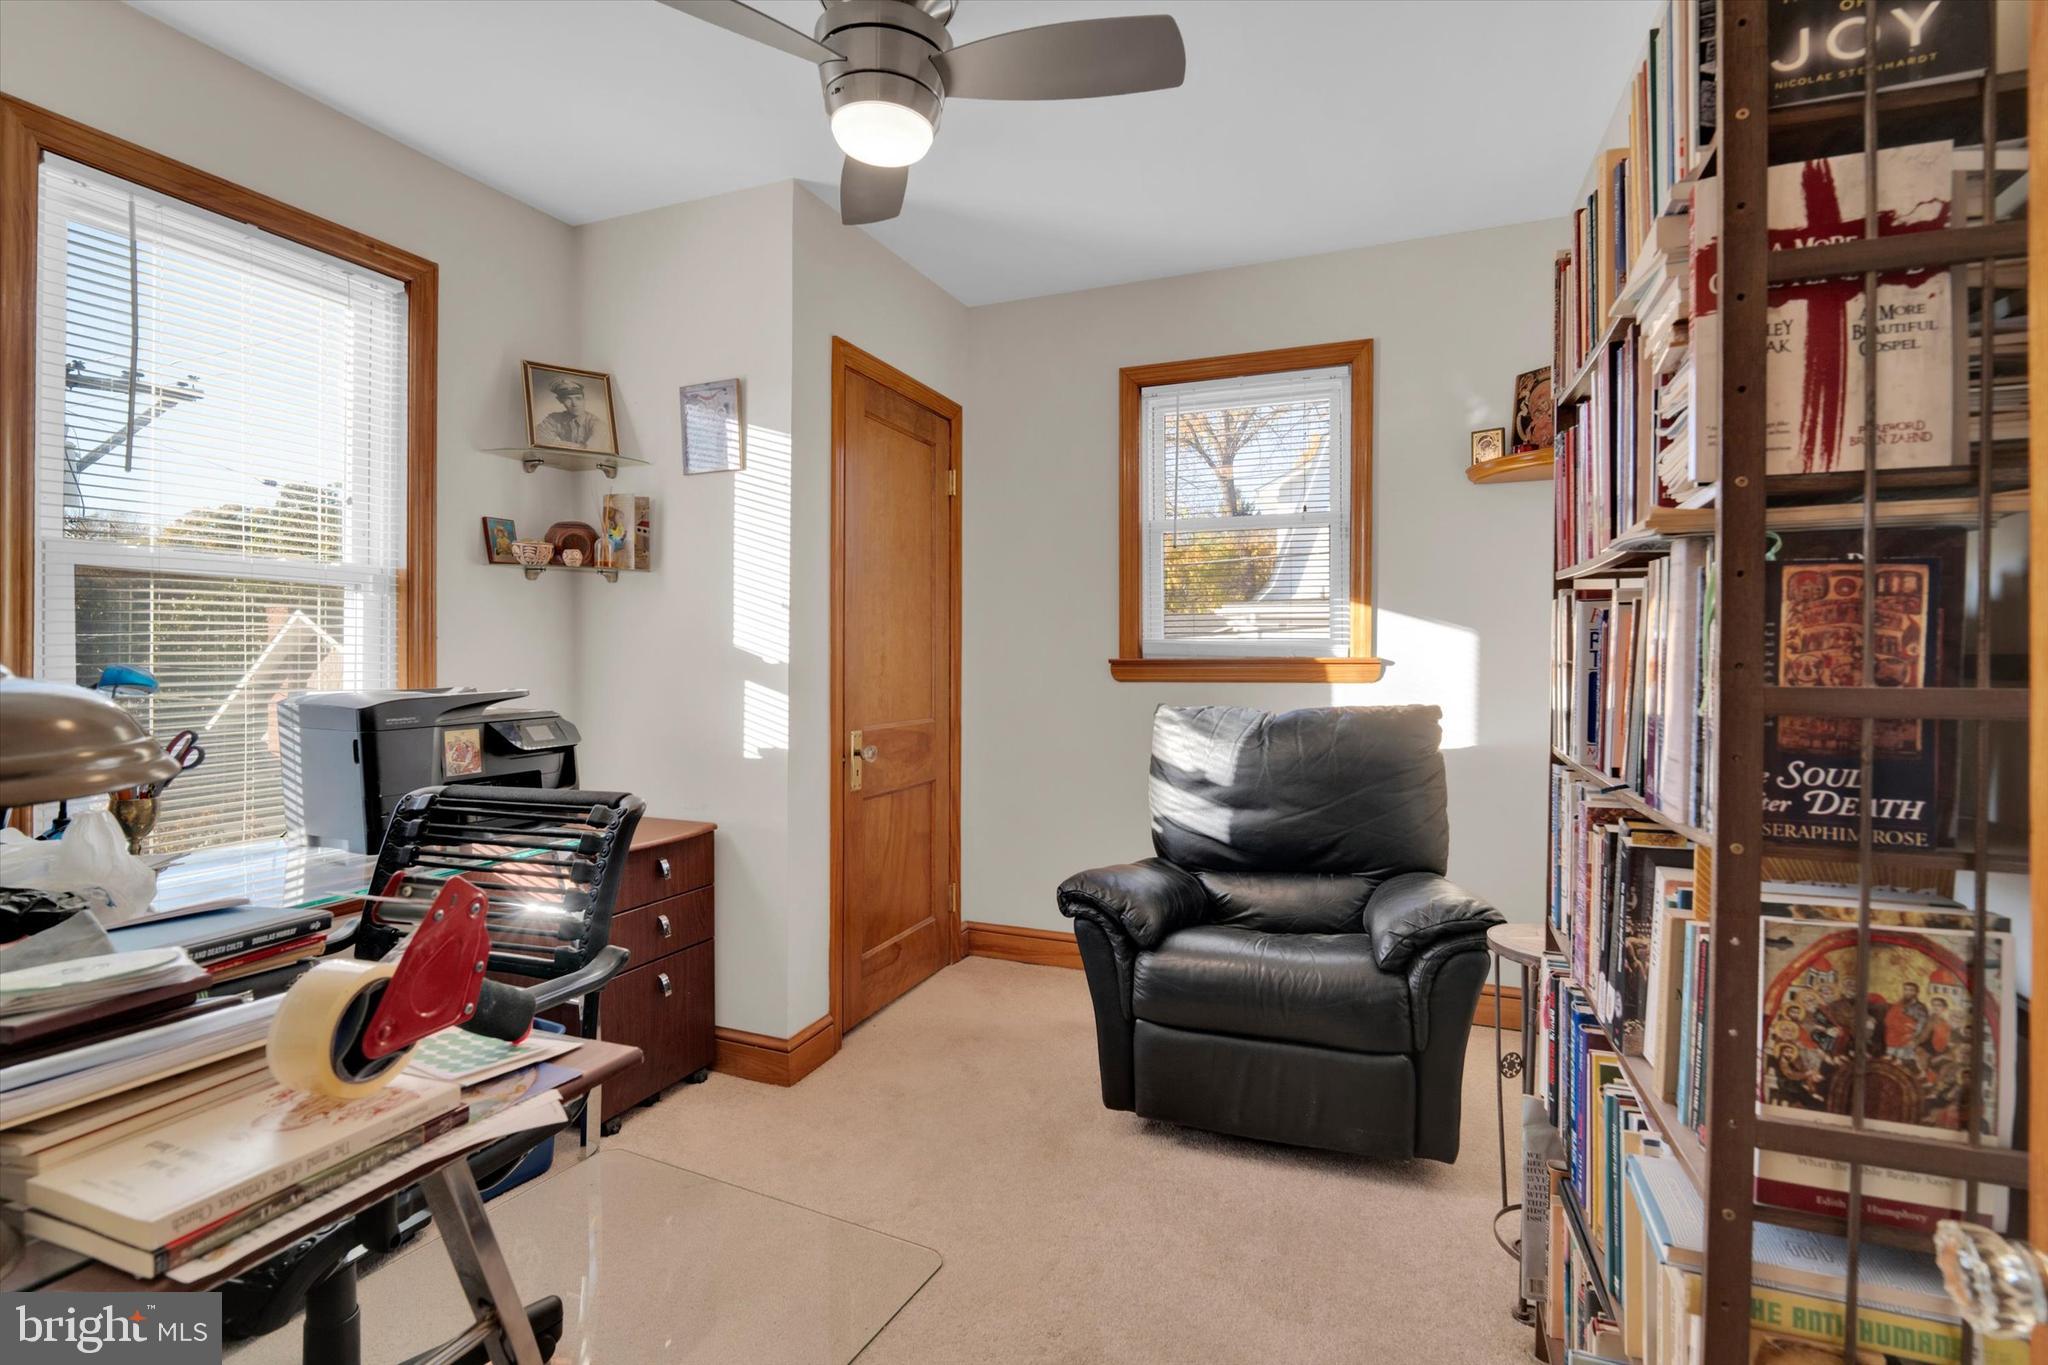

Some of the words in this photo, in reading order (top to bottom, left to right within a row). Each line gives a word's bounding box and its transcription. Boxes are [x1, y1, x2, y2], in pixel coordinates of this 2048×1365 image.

[1770, 1, 1941, 72] JOY
[1774, 73, 1834, 90] NICOLAE
[1838, 52, 1938, 79] STEHARDT
[1879, 303, 1926, 321] MORE
[1850, 431, 1887, 447] BRN
[1890, 431, 1934, 445] ZAHND
[1858, 420, 1926, 434] FREWORD
[1776, 760, 1862, 789] SOUL
[1873, 829, 1929, 848] ROSE
[1752, 1297, 1782, 1326] HE
